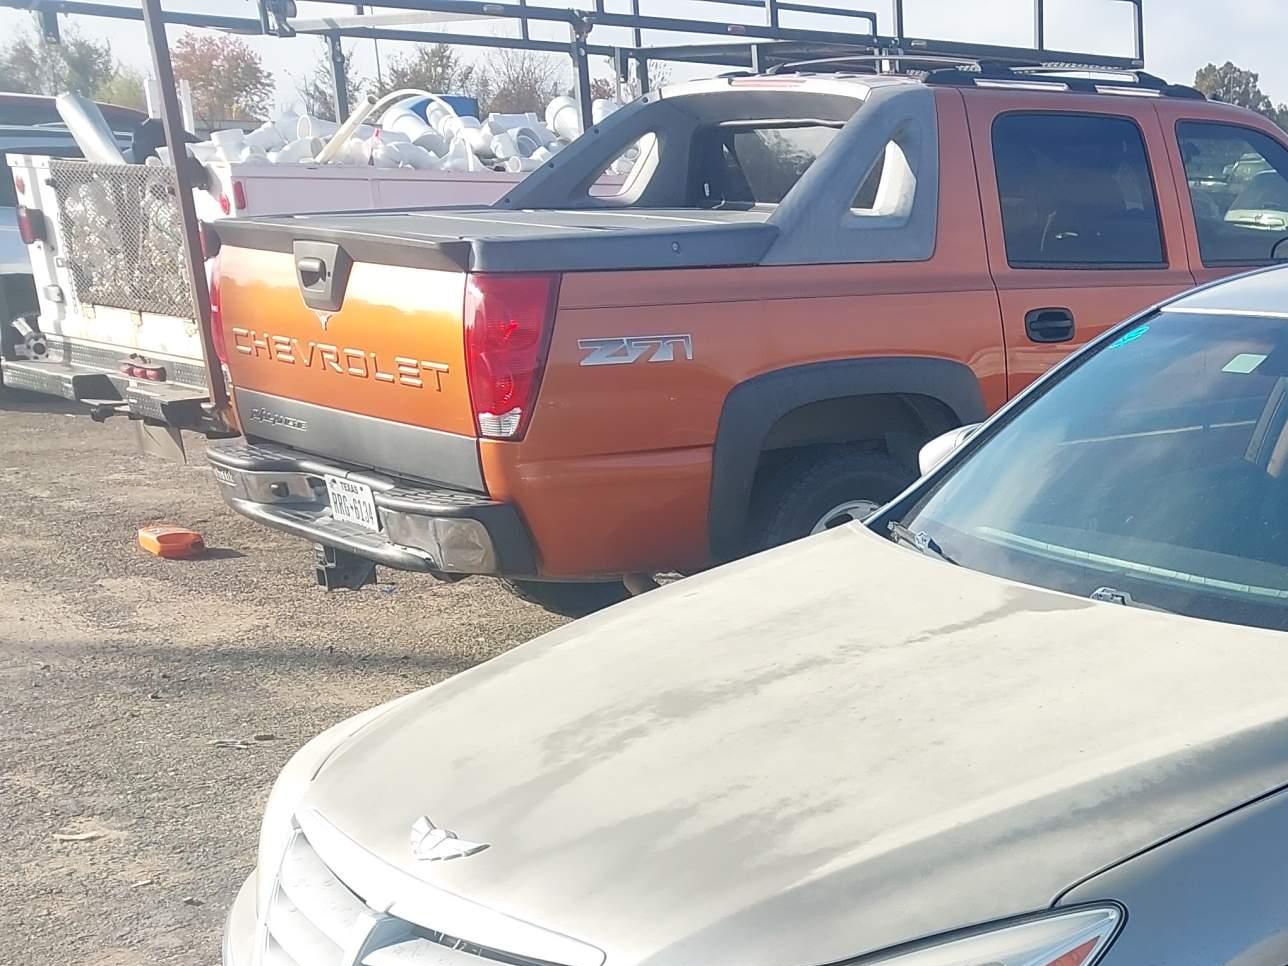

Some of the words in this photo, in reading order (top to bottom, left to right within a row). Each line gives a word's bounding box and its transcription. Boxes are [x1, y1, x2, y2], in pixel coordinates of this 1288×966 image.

[232, 327, 449, 392] CHEVROLET
[577, 334, 693, 366] Z71
[340, 481, 359, 495] TEXAS
